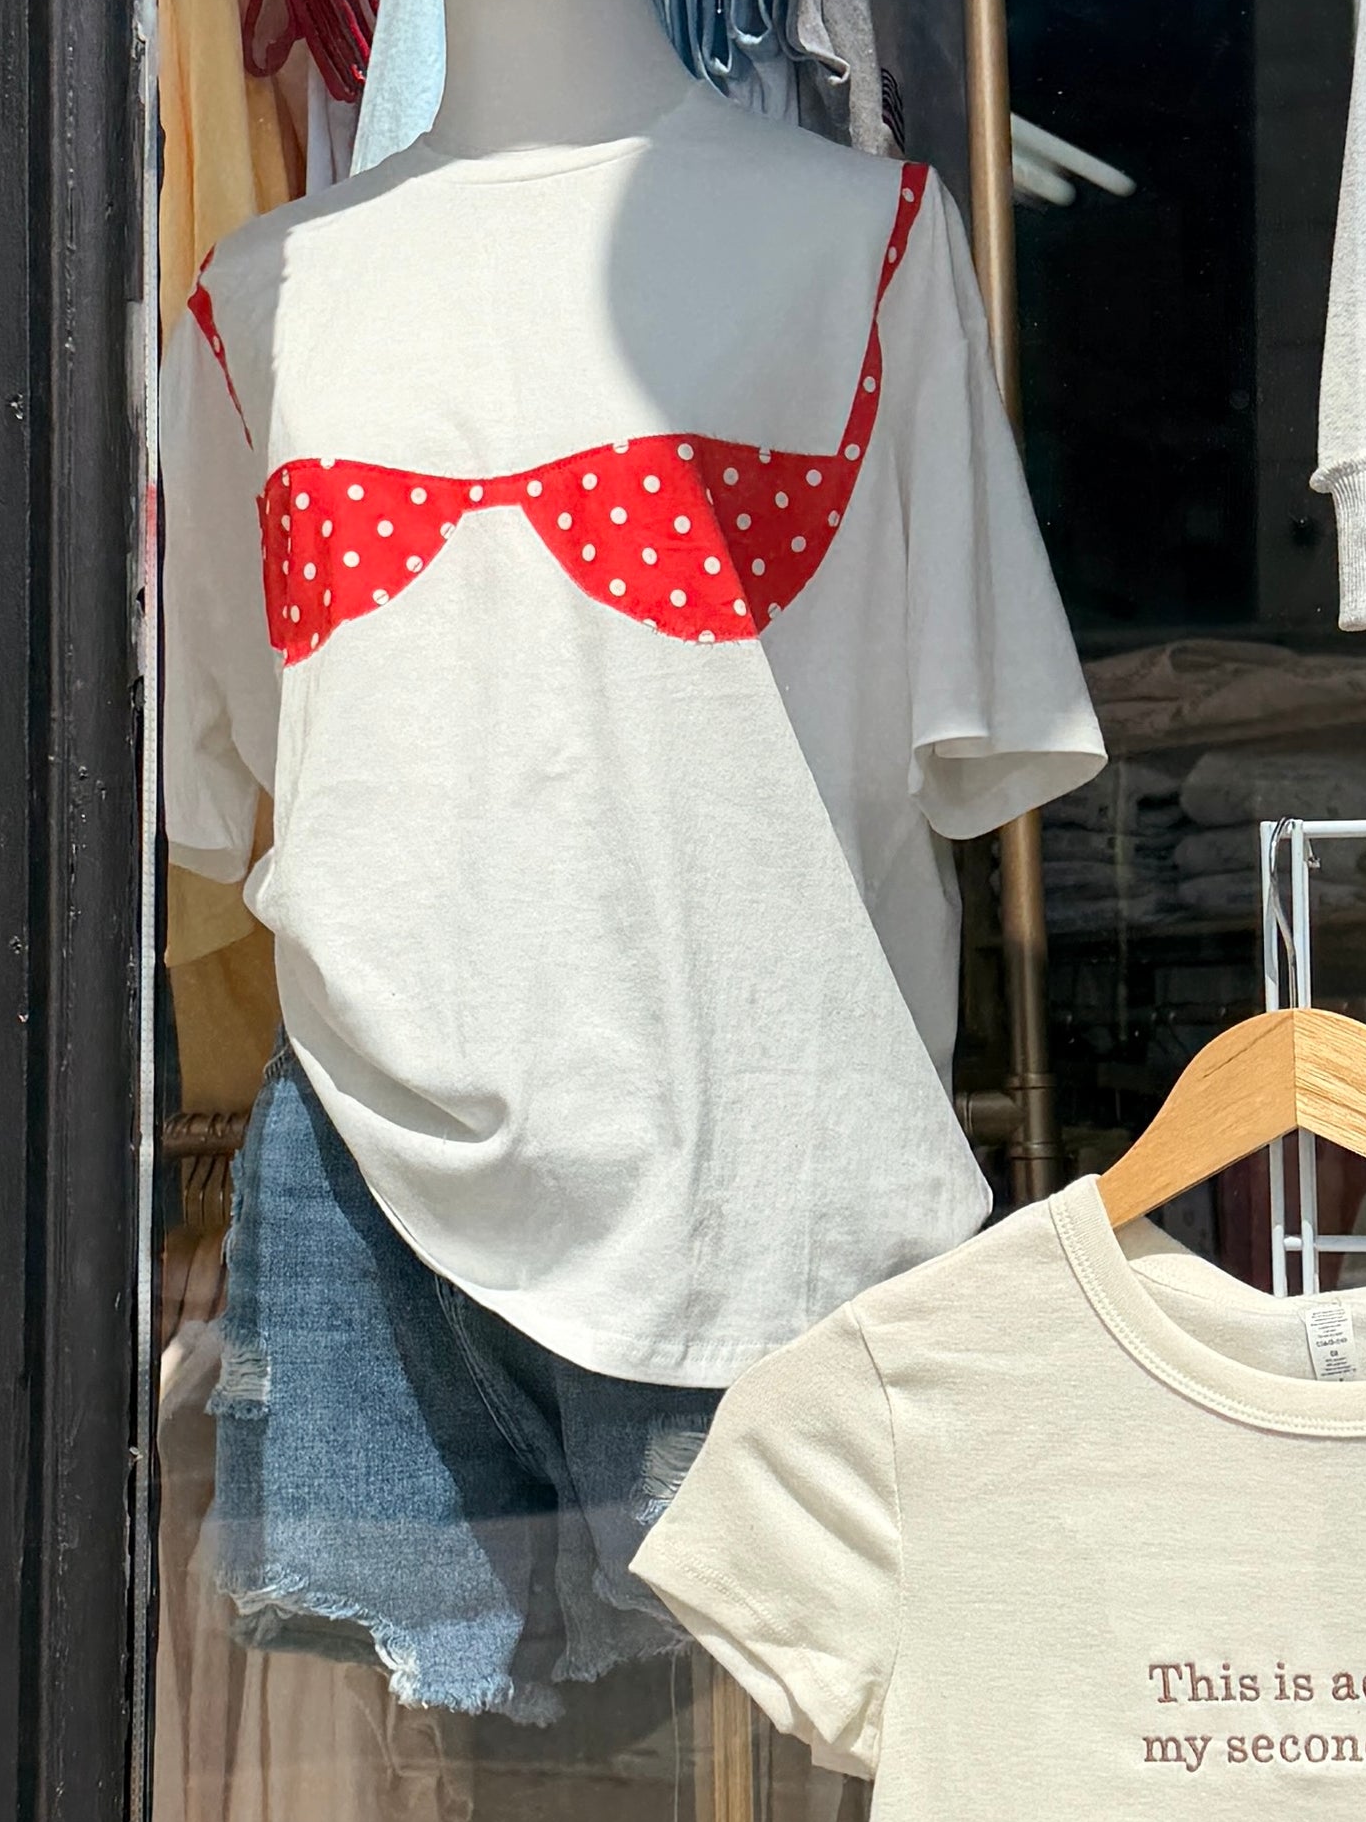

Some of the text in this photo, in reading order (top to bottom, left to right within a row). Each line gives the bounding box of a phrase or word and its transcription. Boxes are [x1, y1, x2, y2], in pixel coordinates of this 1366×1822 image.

[1147, 1661, 1261, 1704] This
[1273, 1661, 1315, 1703] is
[1142, 1734, 1212, 1773] my
